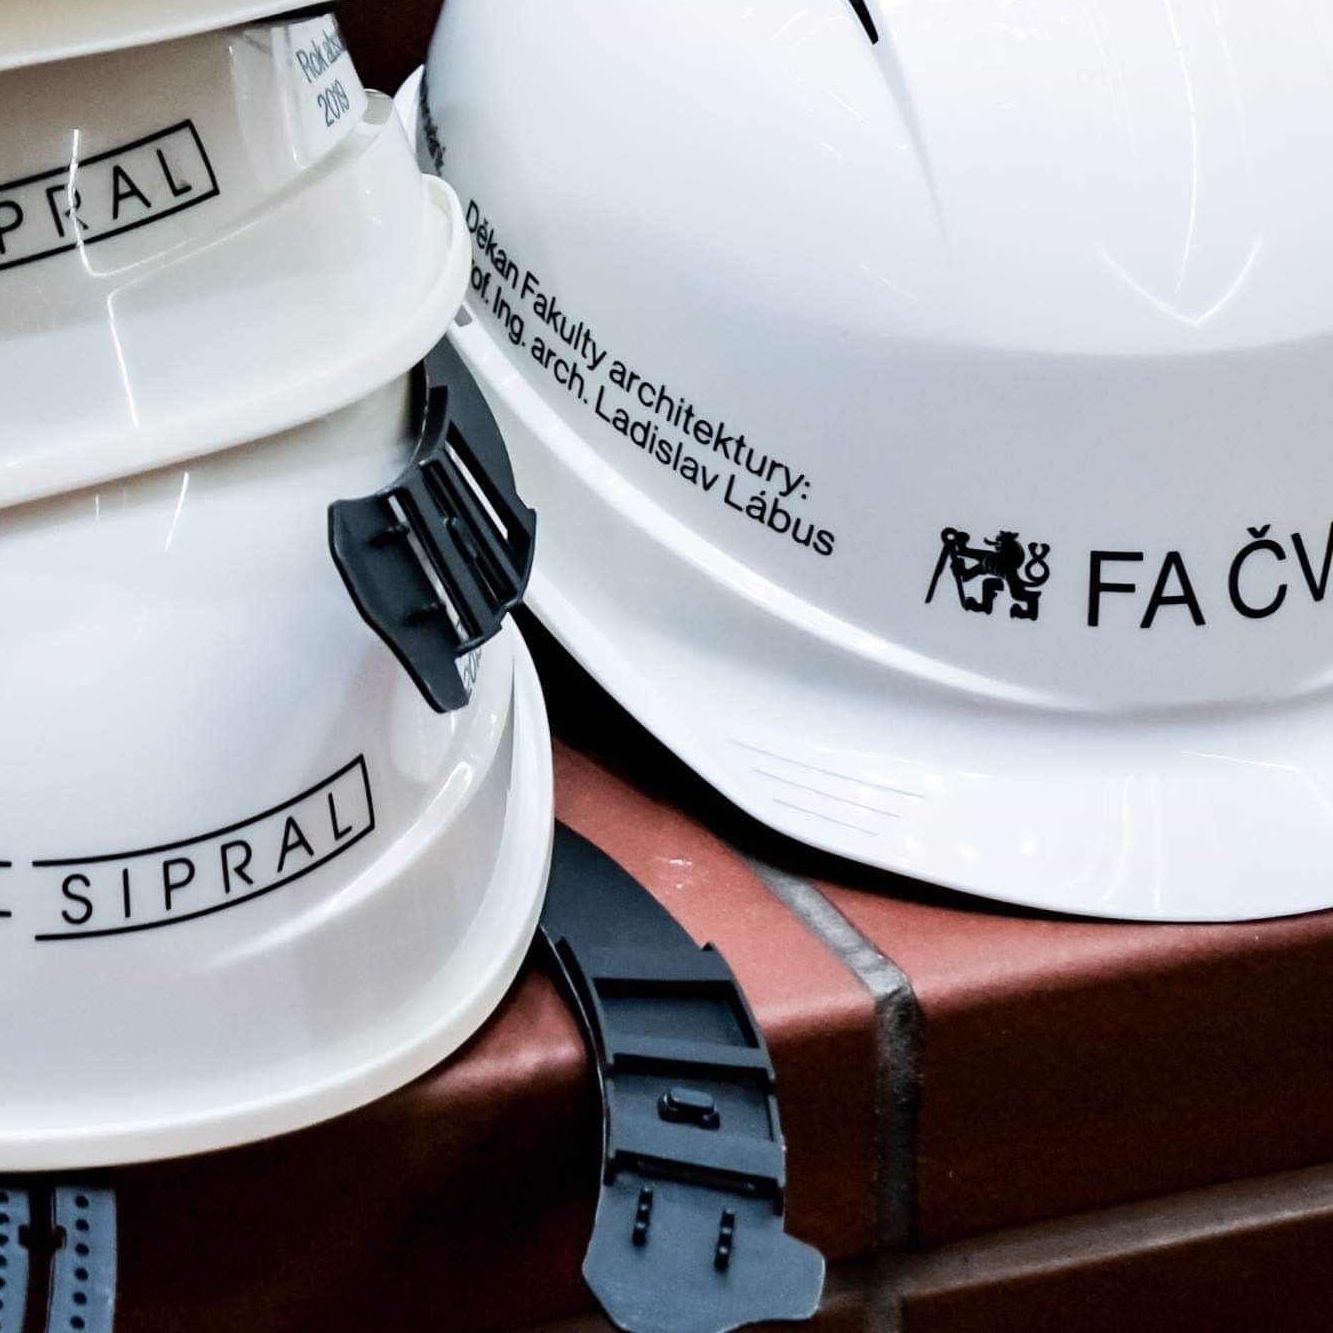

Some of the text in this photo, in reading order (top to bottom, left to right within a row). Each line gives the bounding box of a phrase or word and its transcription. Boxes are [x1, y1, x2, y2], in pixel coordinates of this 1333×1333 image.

[464, 199, 811, 501] Děkan Fakulty architektury:
[492, 285, 836, 558] Ing. arch. Ladislav Lábus
[1087, 522, 1333, 630] FA ČV
[60, 789, 354, 929] SIPRAL
